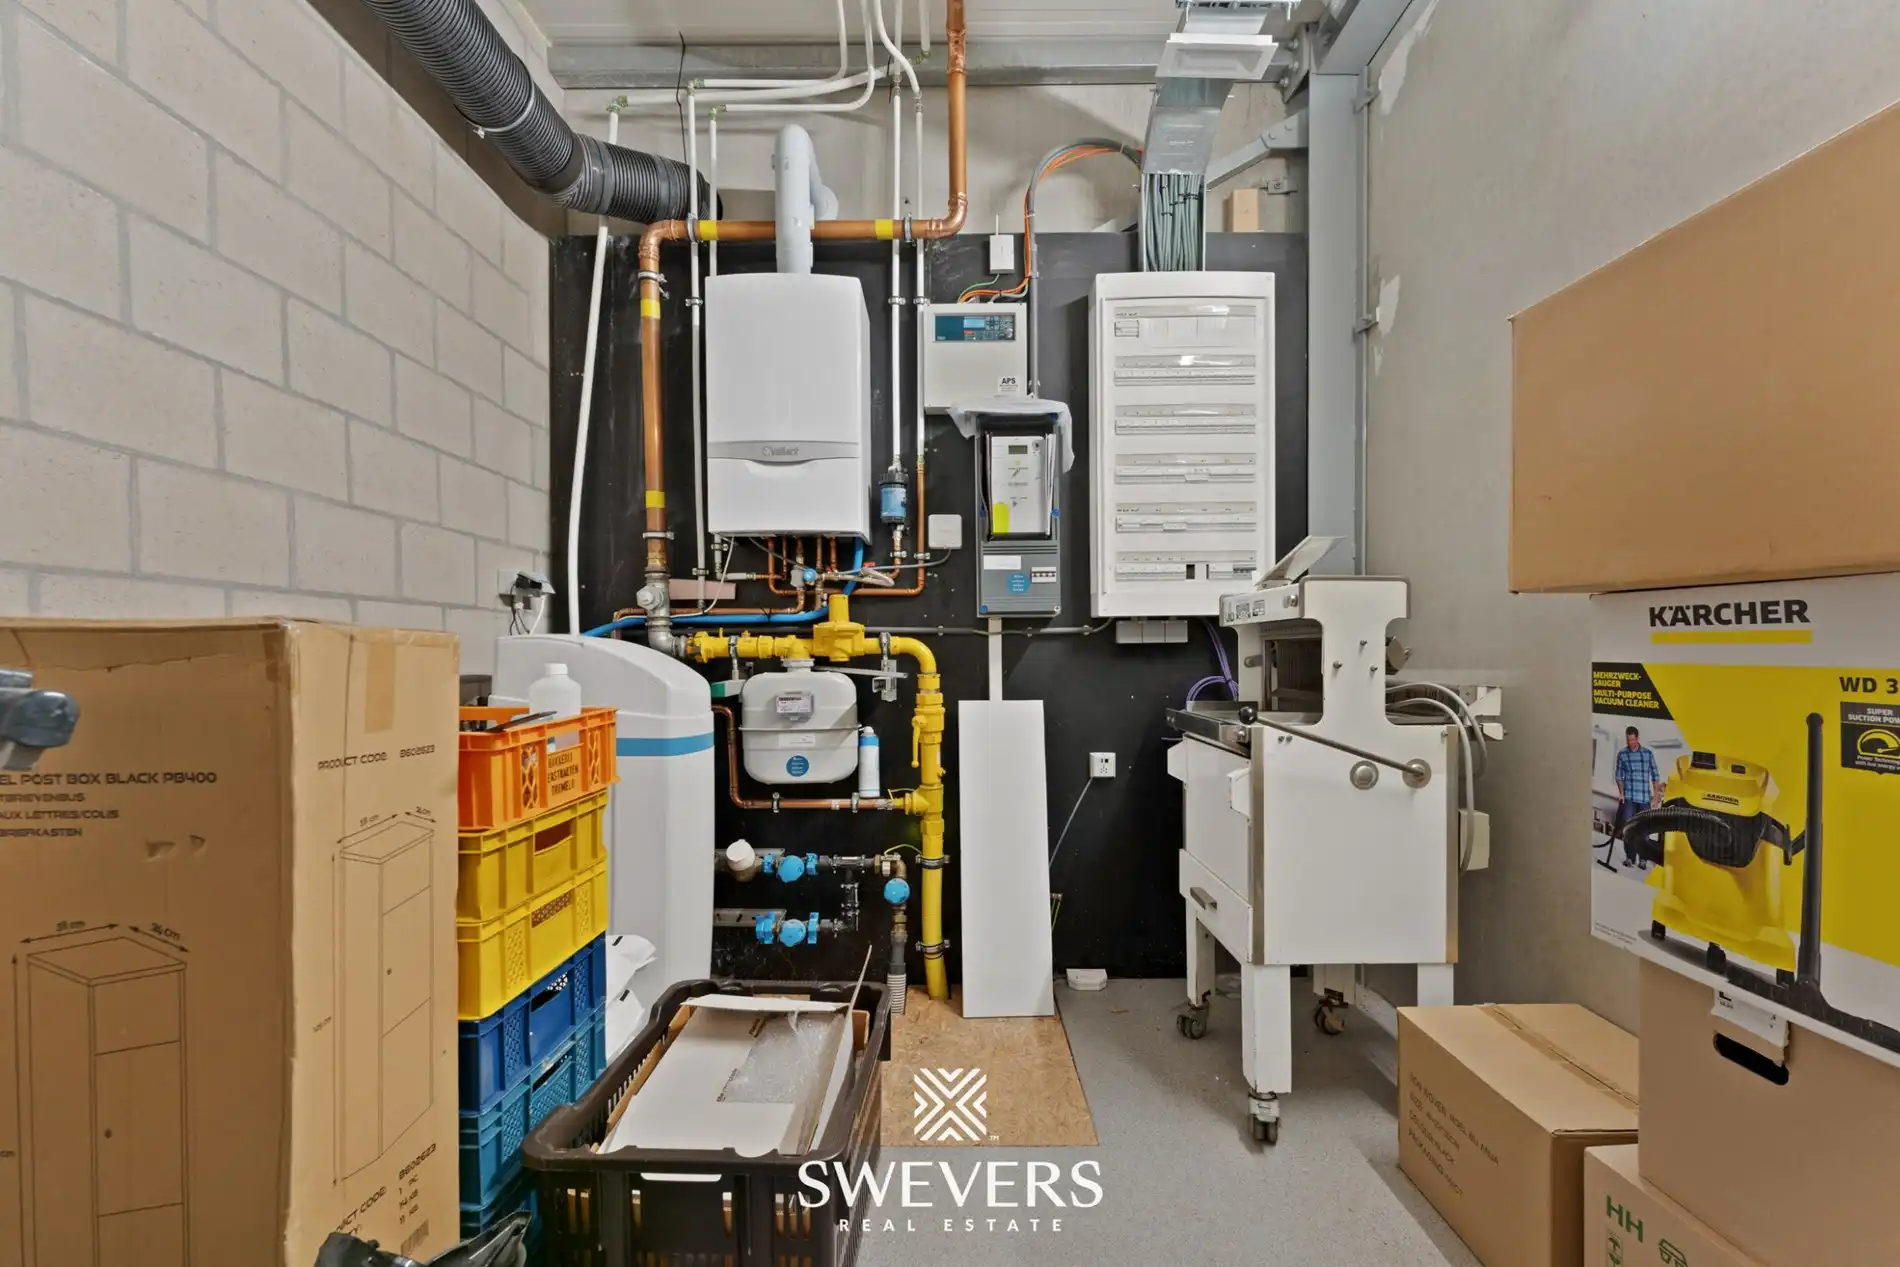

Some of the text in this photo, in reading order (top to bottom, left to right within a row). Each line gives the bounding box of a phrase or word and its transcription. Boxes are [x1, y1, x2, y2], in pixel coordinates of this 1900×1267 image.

[1001, 377, 1017, 385] APS
[1649, 599, 1811, 627] KÄRCHER
[1593, 679, 1622, 688] SAUGER
[1839, 676, 1900, 695] WD 3
[1593, 689, 1653, 700] MULTI-PURPOSE
[1593, 696, 1660, 709] VACUUM CLEANER
[1847, 713, 1882, 723] SUCTION
[1866, 707, 1894, 717] SUPER
[317, 756, 358, 770] PRODUCT
[20, 774, 63, 785] POST
[66, 773, 101, 784] BOX
[105, 772, 160, 784] BLACK
[163, 771, 218, 783] PB400
